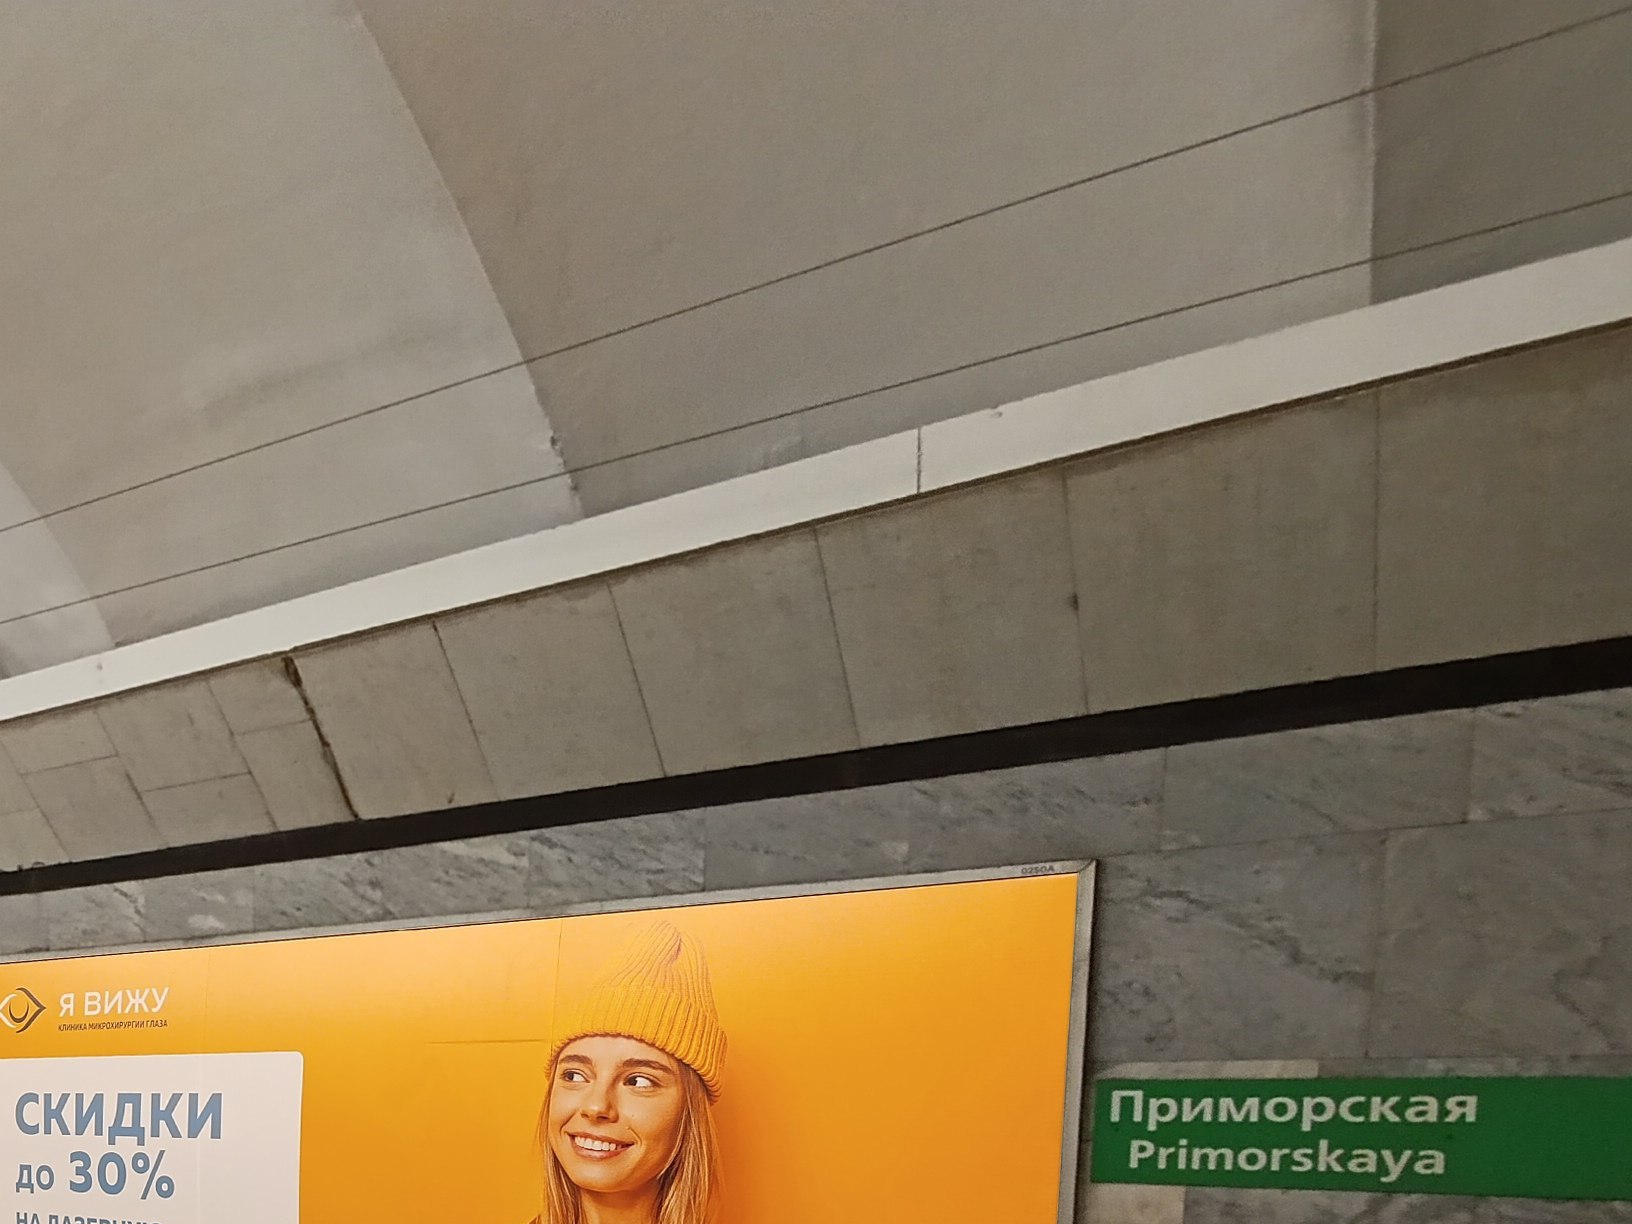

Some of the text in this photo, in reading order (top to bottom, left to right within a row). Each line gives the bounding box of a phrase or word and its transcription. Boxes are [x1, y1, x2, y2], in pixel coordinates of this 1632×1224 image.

[58, 987, 170, 1018] Я ВИЖУ
[58, 1019, 168, 1032] КЛИНИКА МИКРОХИРУРГИИ ГЛАЗА
[15, 1092, 223, 1147] СКИДКИ
[1109, 1089, 1479, 1132] Приморская
[69, 1150, 175, 1200] 30%
[1128, 1139, 1446, 1183] Primorskaya
